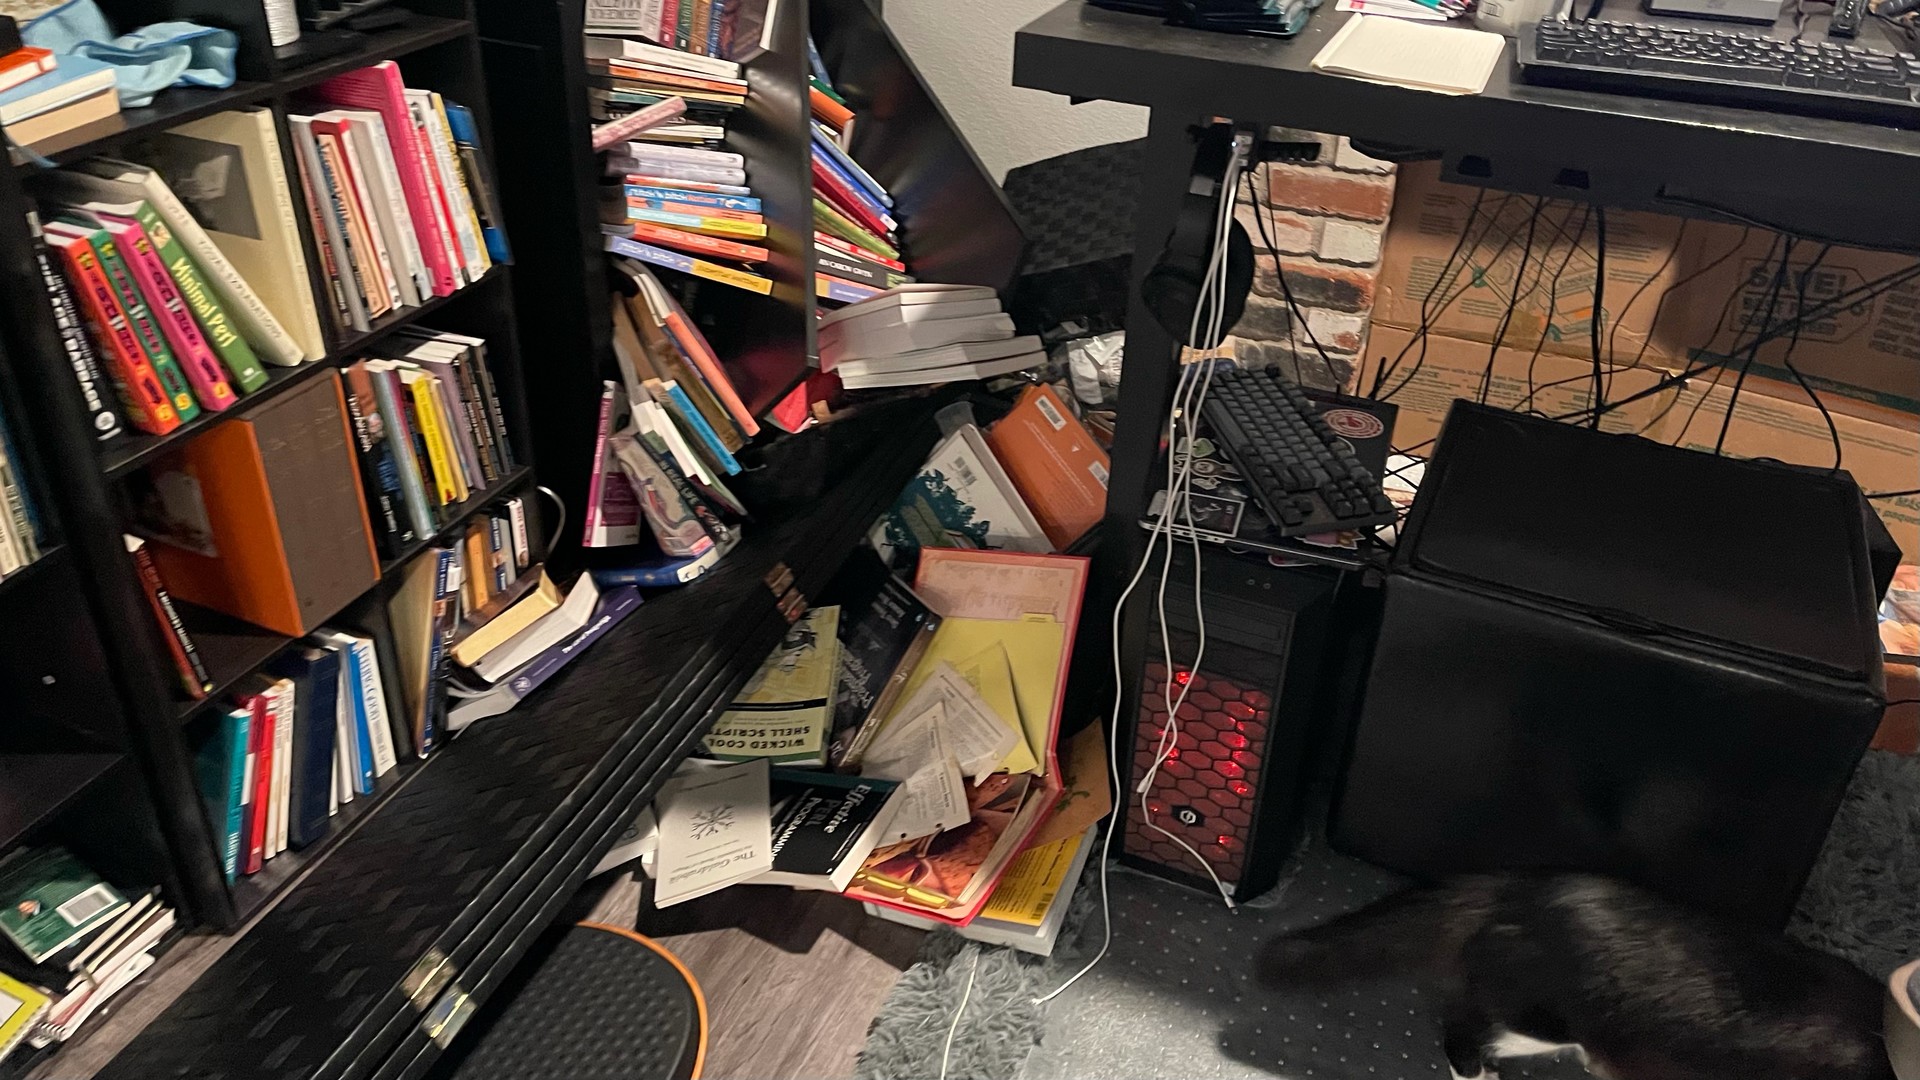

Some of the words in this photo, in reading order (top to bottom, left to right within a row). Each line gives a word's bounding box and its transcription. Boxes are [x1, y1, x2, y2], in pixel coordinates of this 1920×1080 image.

[169, 255, 218, 319] Minimal
[205, 312, 237, 348] Perl
[770, 726, 811, 737] SHELL
[708, 738, 745, 749] COOL
[749, 738, 805, 749] WICKED
[804, 798, 841, 827] PERL
[823, 784, 872, 834] Effective
[731, 850, 757, 862] The
